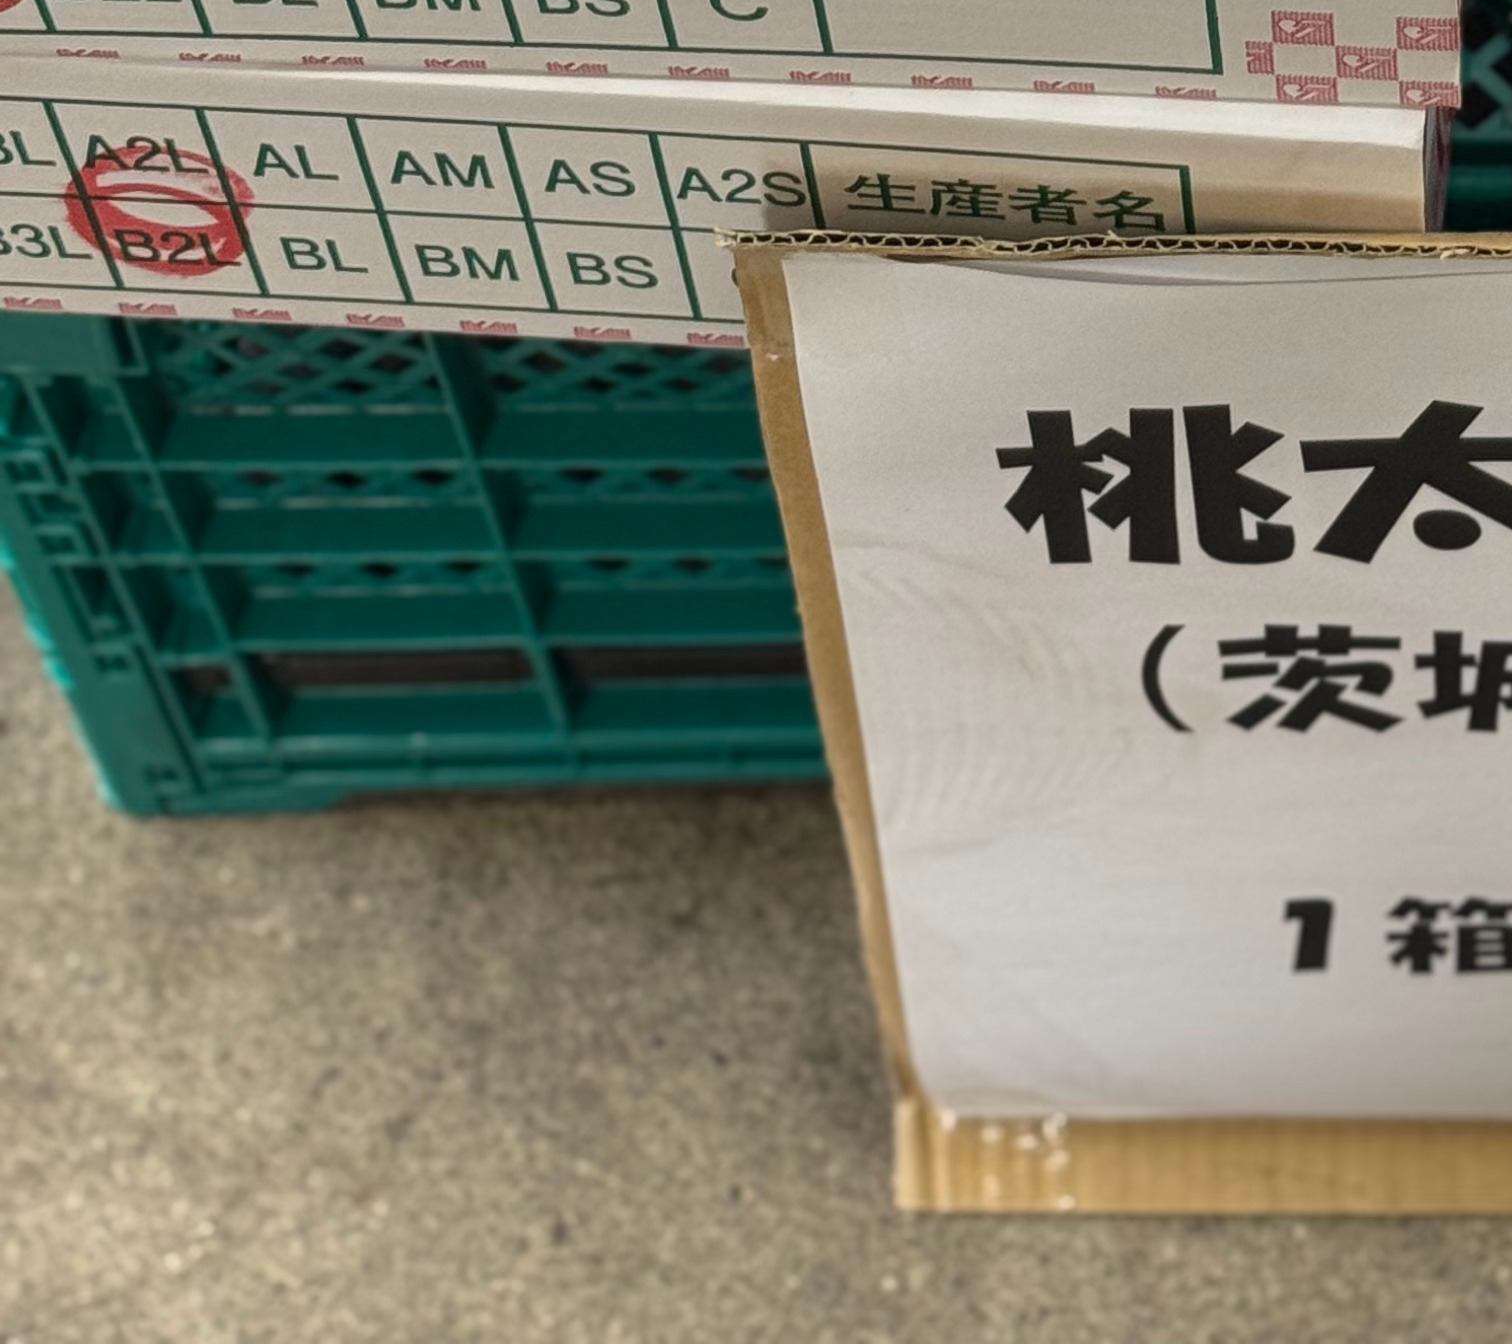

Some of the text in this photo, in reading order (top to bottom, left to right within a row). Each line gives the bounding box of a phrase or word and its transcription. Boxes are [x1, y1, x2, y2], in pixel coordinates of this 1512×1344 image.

[83, 134, 208, 174] A2L
[253, 143, 339, 182] AL
[390, 150, 494, 190] AM
[544, 159, 637, 197] AS
[677, 167, 806, 206] A2S
[843, 173, 1166, 232] 生産者名
[114, 229, 242, 266] B2L
[279, 237, 369, 274] BL
[415, 243, 520, 282] BM
[565, 252, 660, 290] BS
